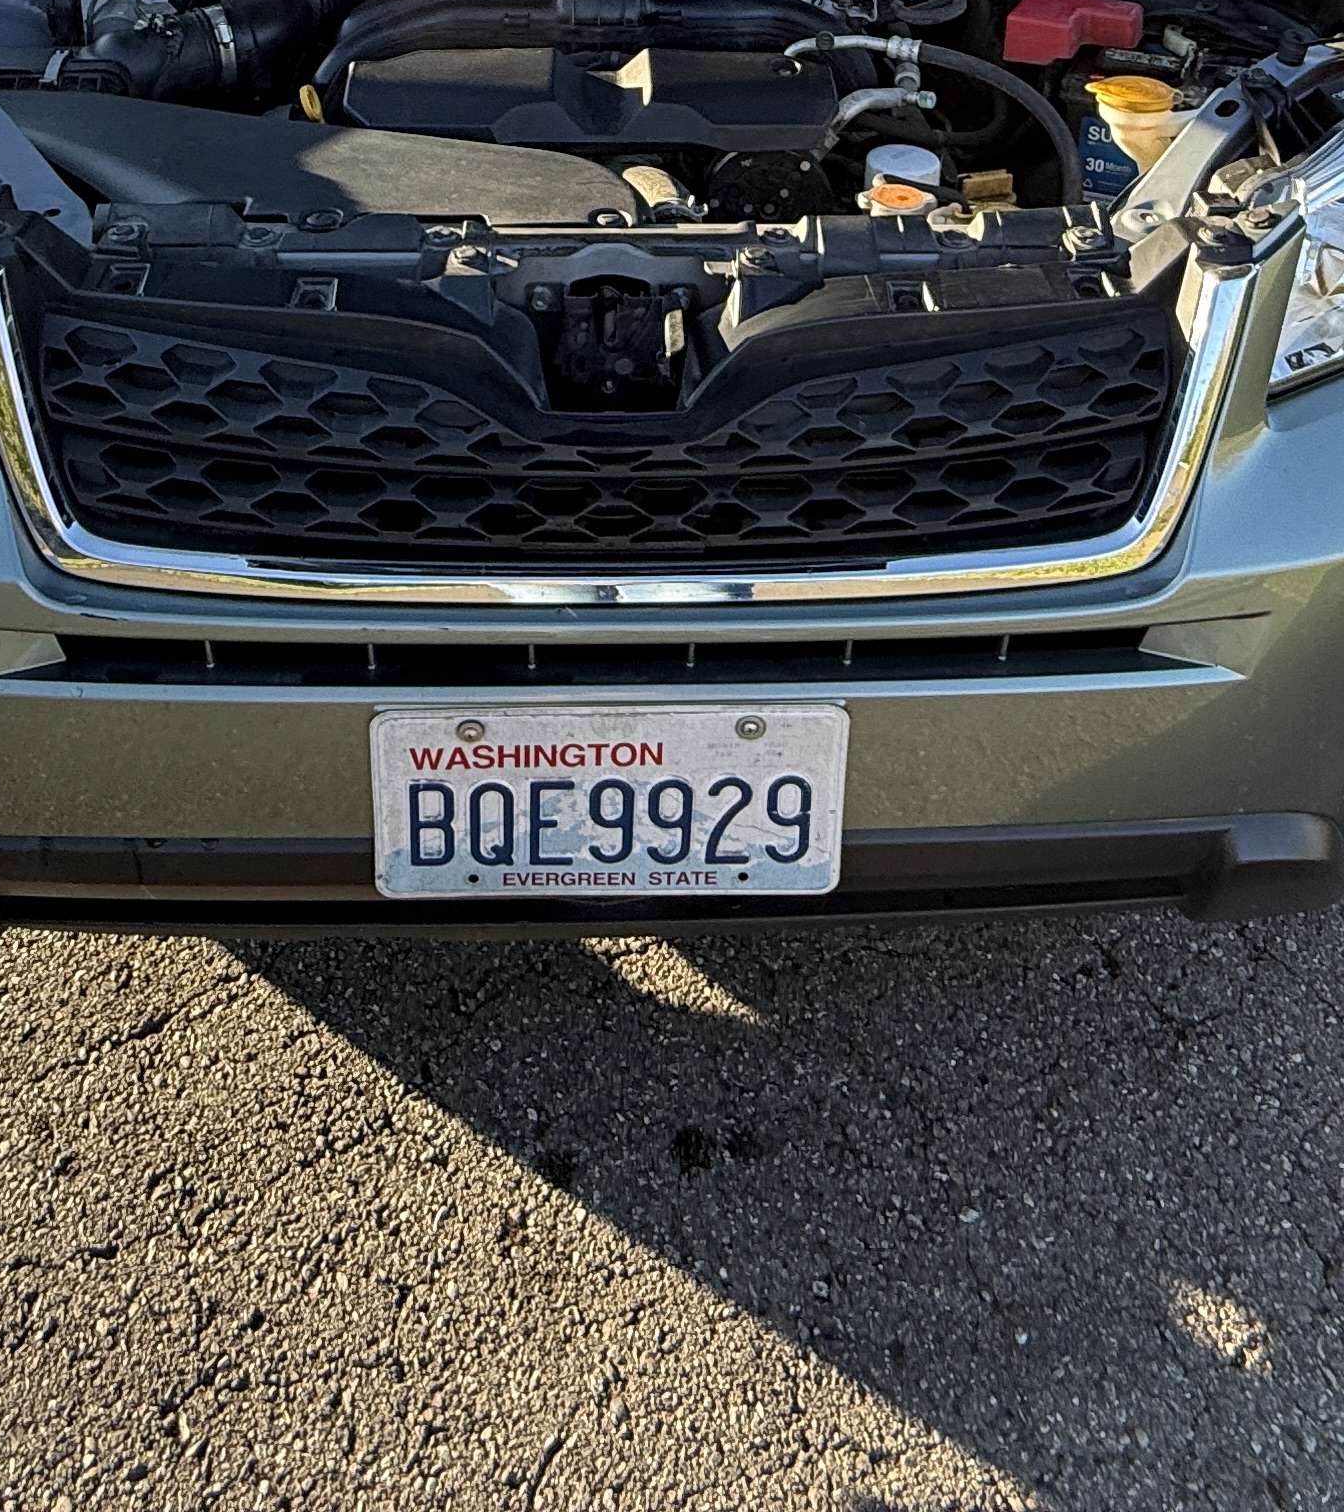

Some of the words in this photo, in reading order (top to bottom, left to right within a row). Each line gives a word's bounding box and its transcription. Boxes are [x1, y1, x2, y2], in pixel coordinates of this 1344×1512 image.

[1085, 157, 1105, 173] 30
[409, 741, 664, 771] WASHINGTON
[409, 774, 812, 866] BQE9929
[503, 871, 636, 887] EVERGREEN
[648, 870, 718, 886] STATE
